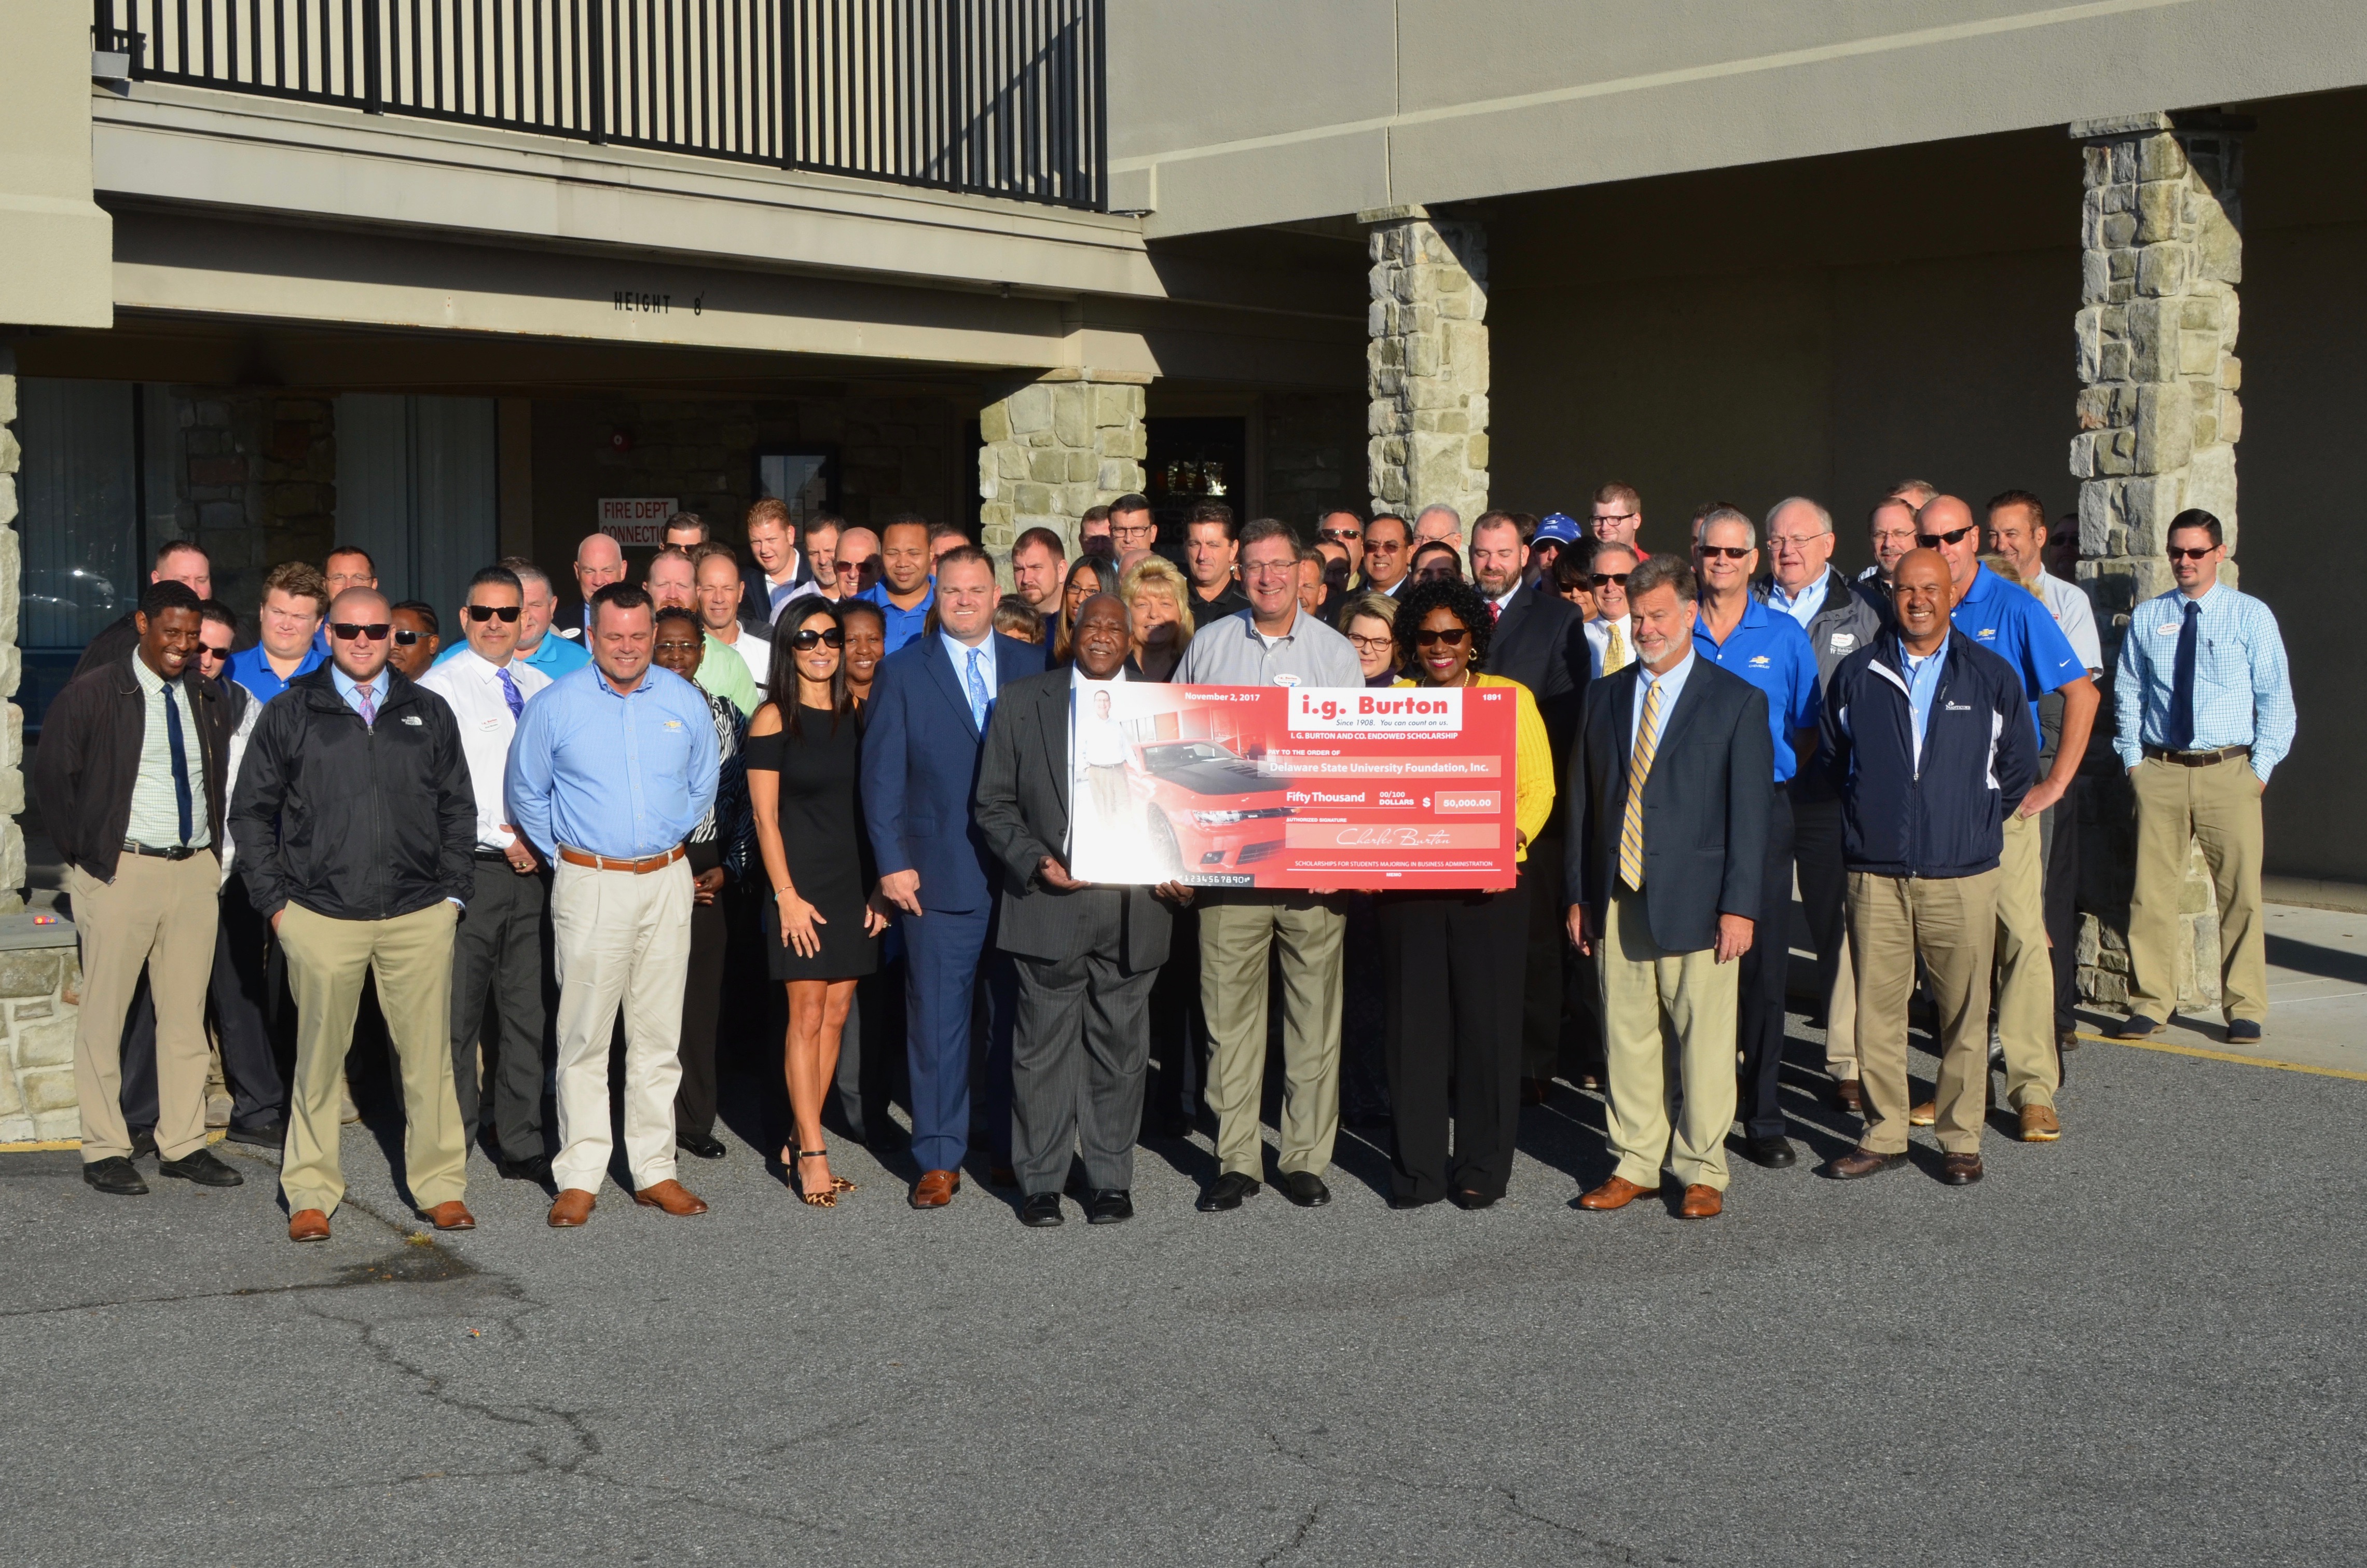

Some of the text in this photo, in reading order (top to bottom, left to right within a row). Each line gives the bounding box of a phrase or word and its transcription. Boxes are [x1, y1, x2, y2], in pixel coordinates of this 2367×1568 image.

[614, 291, 670, 313] HEIGHT
[604, 502, 632, 518] FIRE
[1185, 692, 1229, 700] November
[1302, 694, 1448, 720] i.g. Burton
[1270, 762, 1489, 775] Delaware State University Foundation, Inc.
[1286, 791, 1365, 804] Fifty Thousand
[1422, 797, 1431, 808] $
[1443, 799, 1492, 808] 50,000.00
[1337, 828, 1451, 845] Charles Burton
